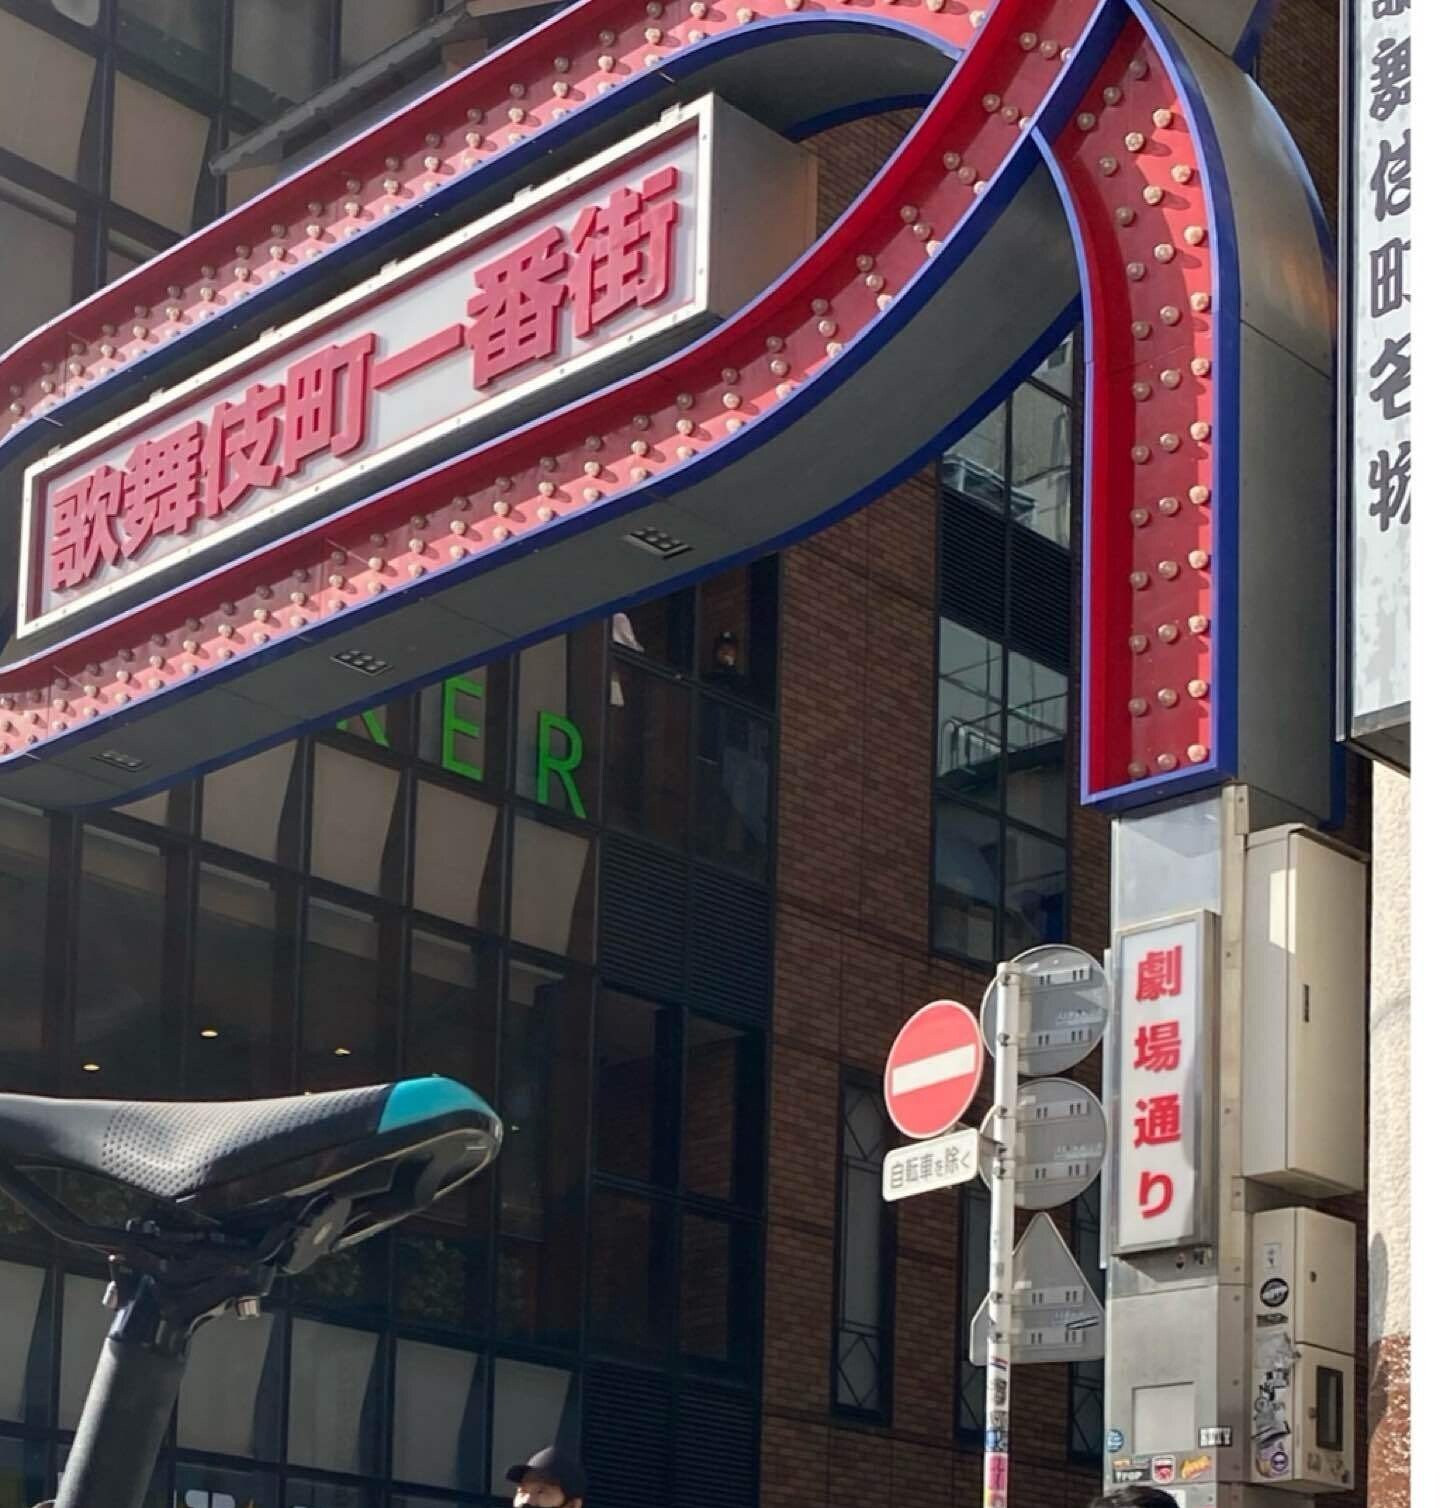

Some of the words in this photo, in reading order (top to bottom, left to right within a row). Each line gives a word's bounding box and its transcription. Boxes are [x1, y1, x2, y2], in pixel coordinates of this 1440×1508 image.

[50, 166, 678, 592] 歌舞伎町一番街
[1133, 944, 1184, 1220] 劇場通り
